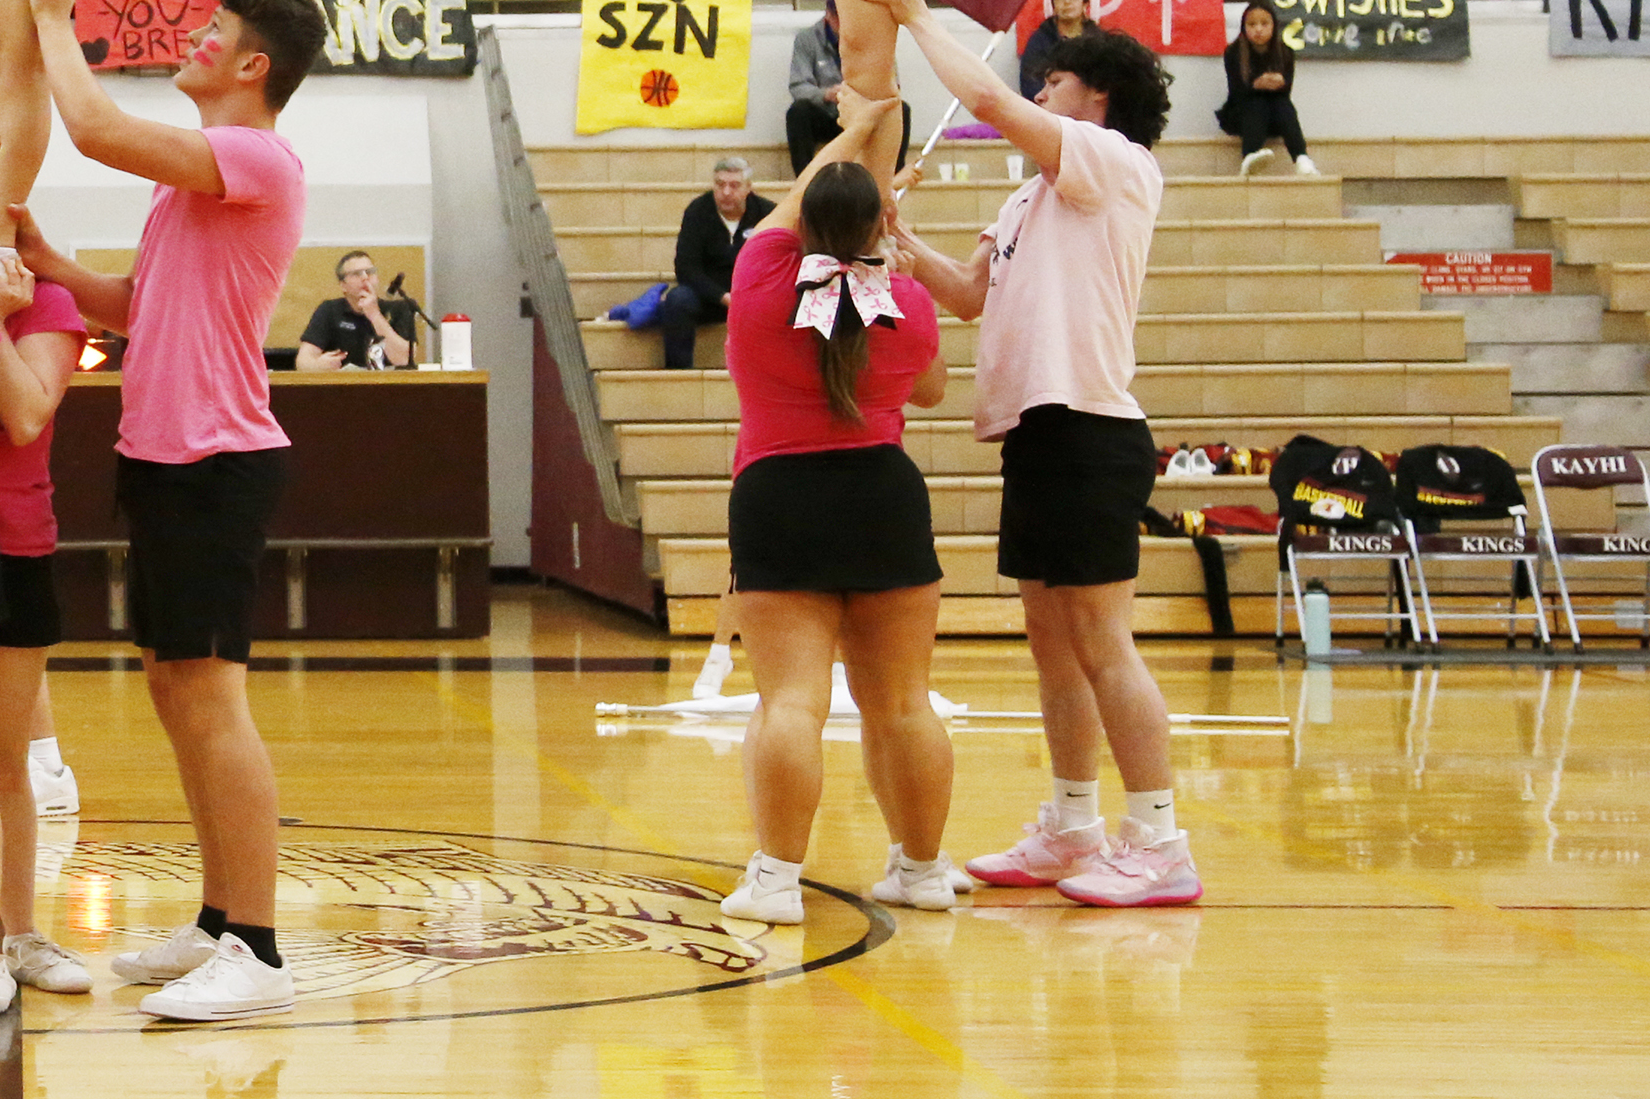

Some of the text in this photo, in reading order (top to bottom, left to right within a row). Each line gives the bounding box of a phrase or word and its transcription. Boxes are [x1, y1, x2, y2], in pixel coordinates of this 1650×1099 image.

[596, 1, 719, 59] SZN
[1445, 252, 1492, 265] CAUTION
[1551, 455, 1627, 475] KAYHI
[1328, 535, 1393, 552] KINGS
[1462, 536, 1525, 553] KINGS
